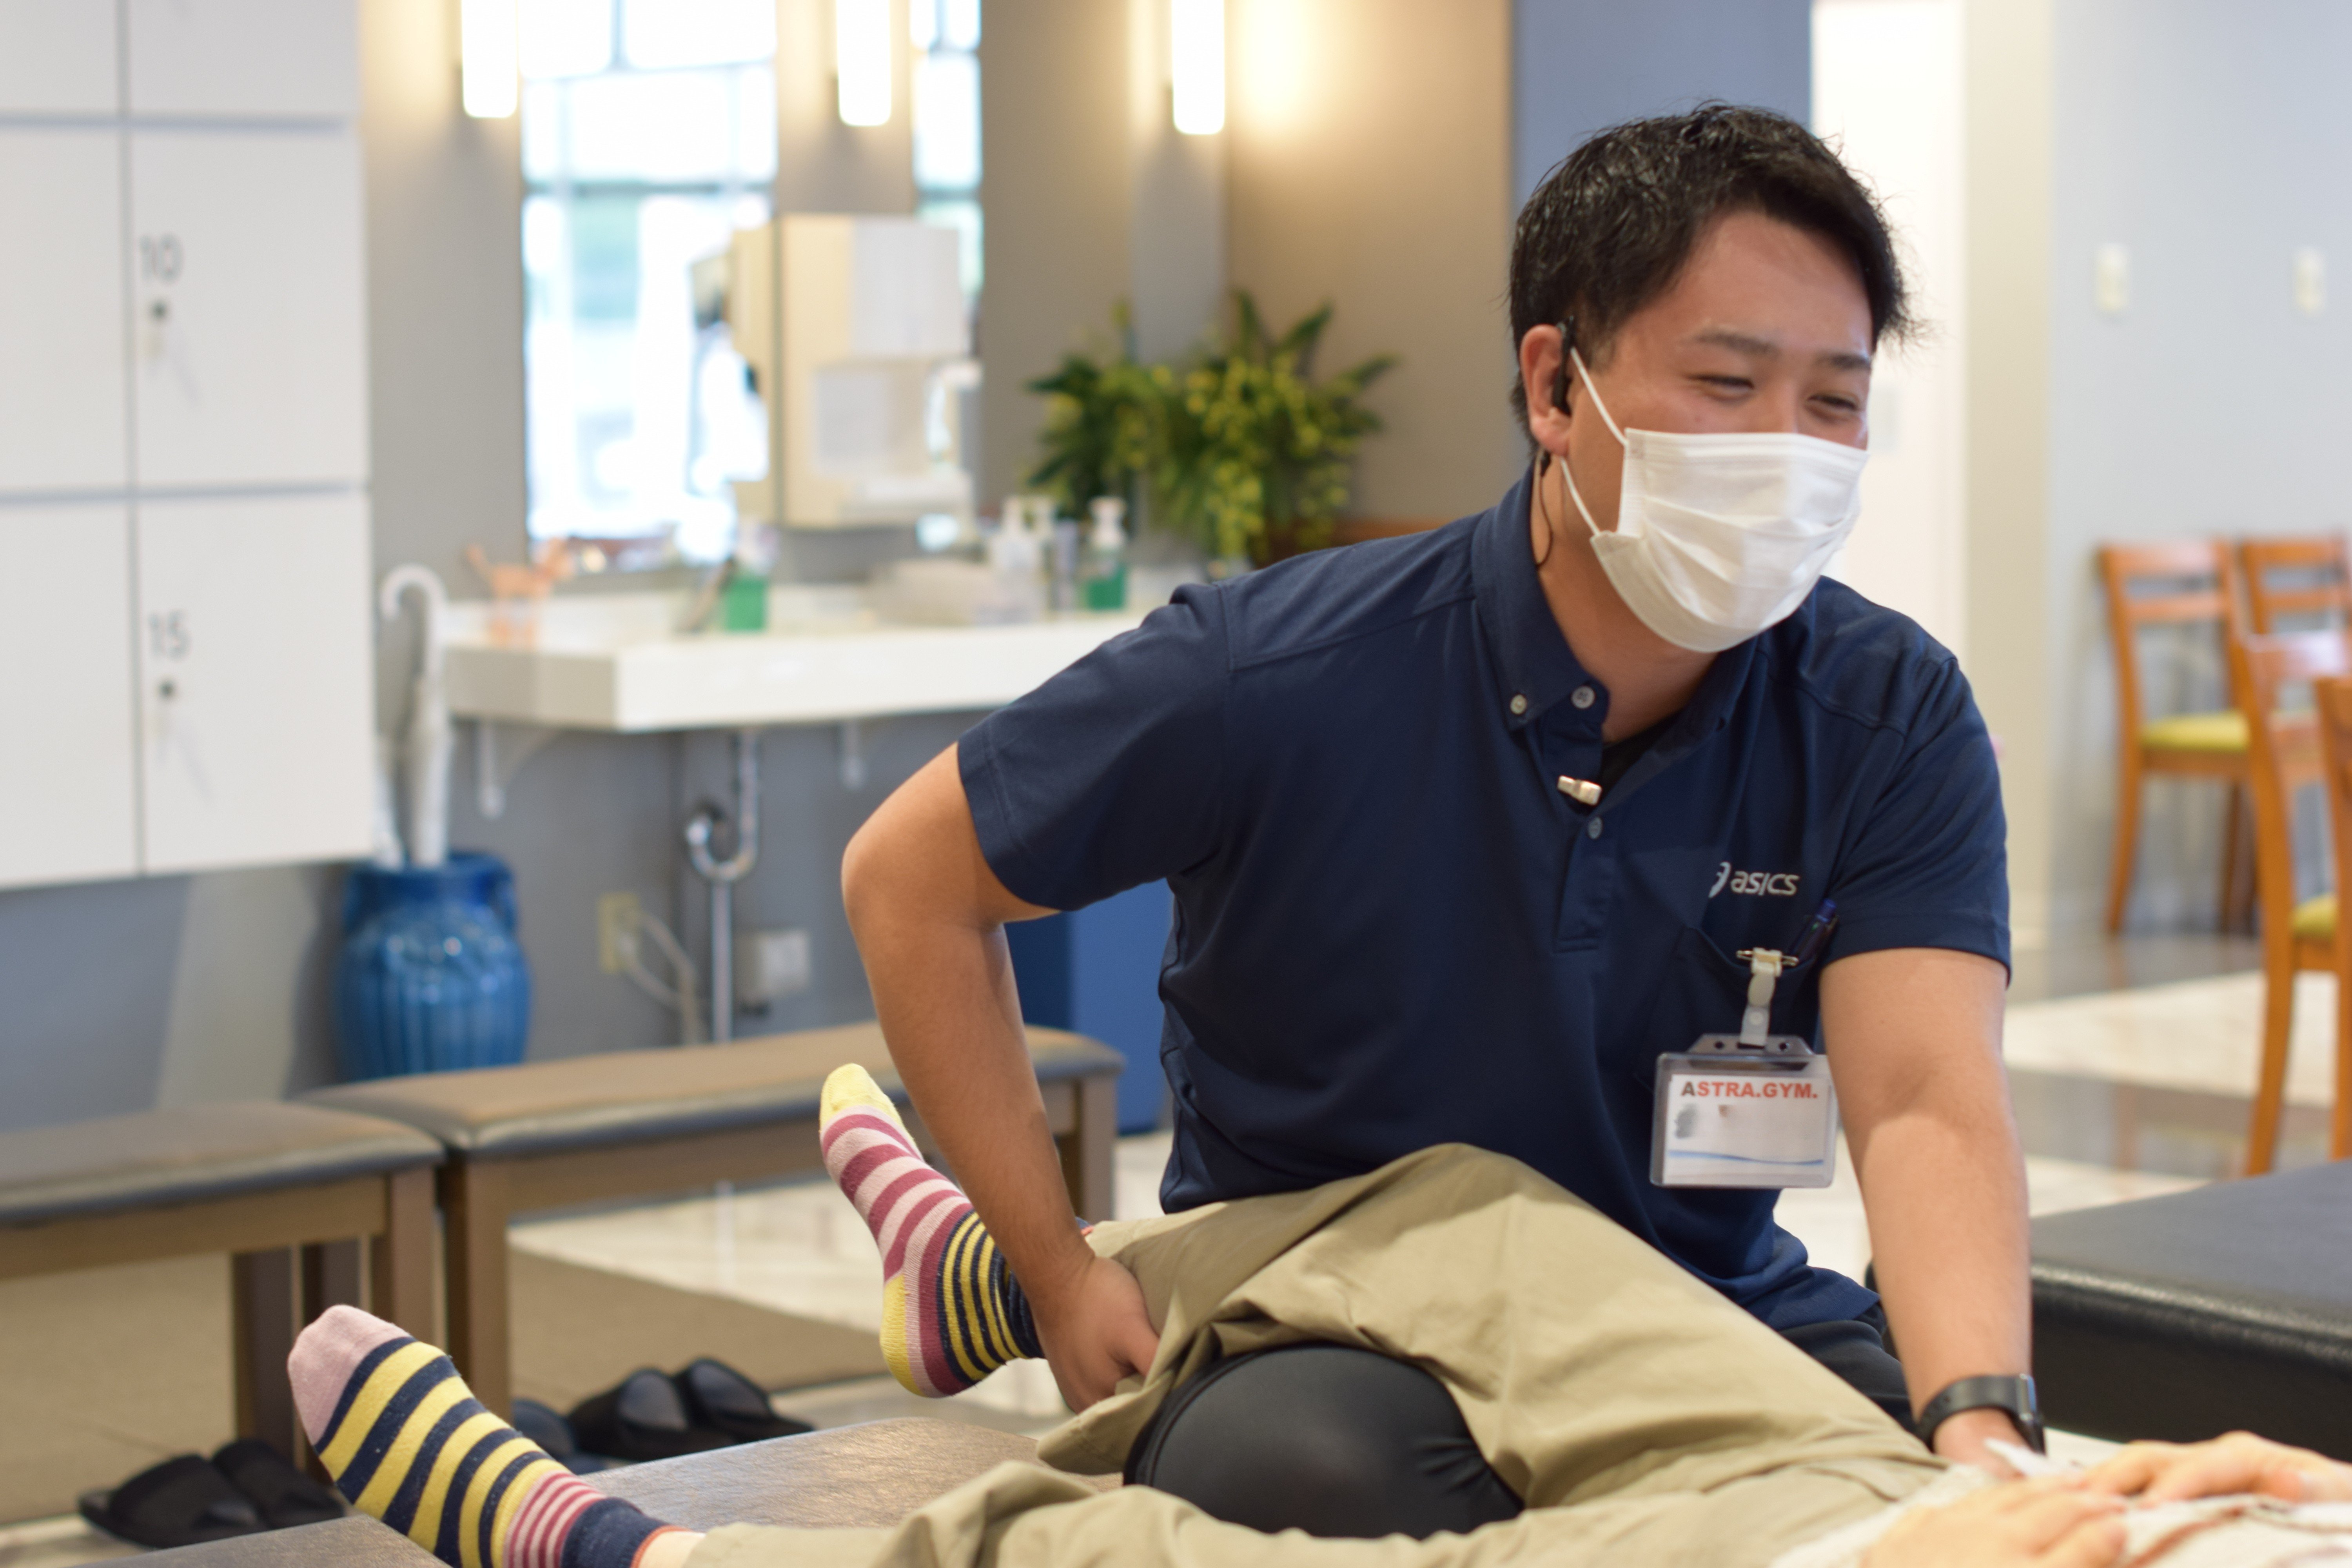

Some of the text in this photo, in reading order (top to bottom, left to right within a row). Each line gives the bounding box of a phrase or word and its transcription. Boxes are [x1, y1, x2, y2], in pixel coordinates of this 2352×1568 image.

[139, 234, 183, 283] 10
[148, 610, 191, 660] 15
[1730, 870, 1800, 896] asics
